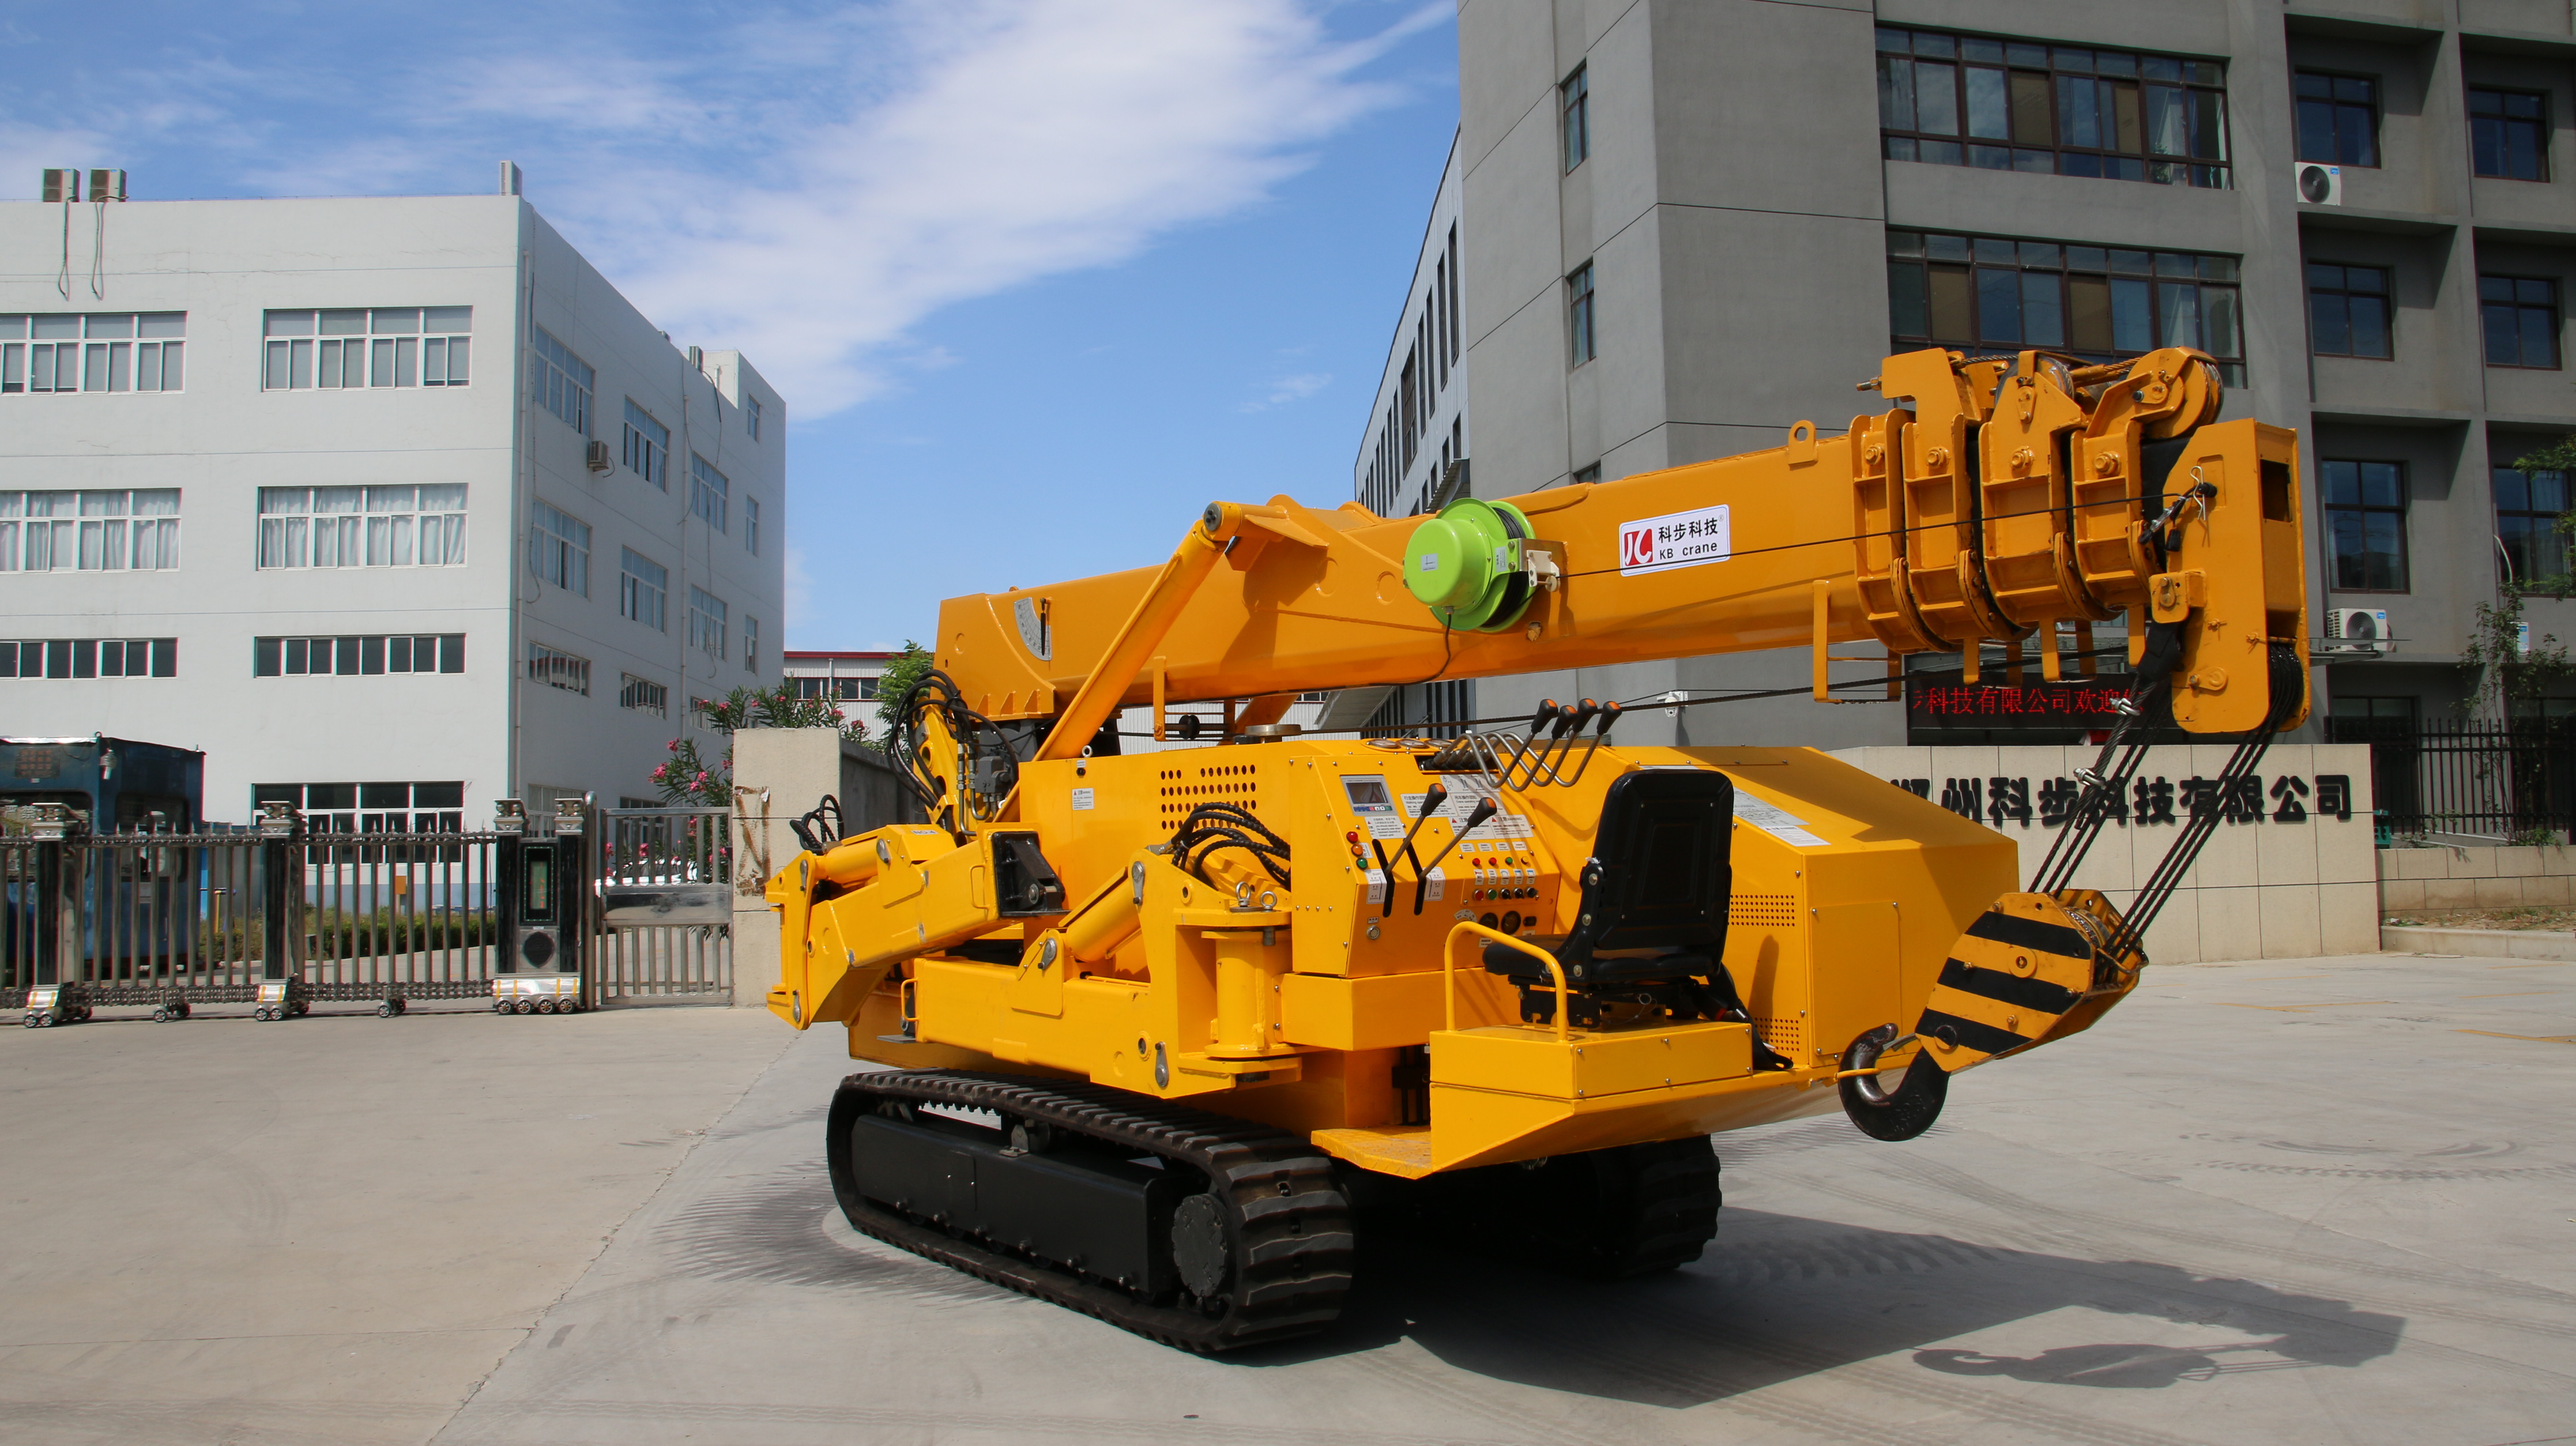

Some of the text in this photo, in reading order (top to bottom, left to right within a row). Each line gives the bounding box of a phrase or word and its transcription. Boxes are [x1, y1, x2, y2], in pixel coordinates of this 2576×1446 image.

[1658, 517, 1718, 543] 科步科技
[1659, 542, 1717, 560] KB crane
[1913, 688, 2144, 715] 科技有限公司欢迎
